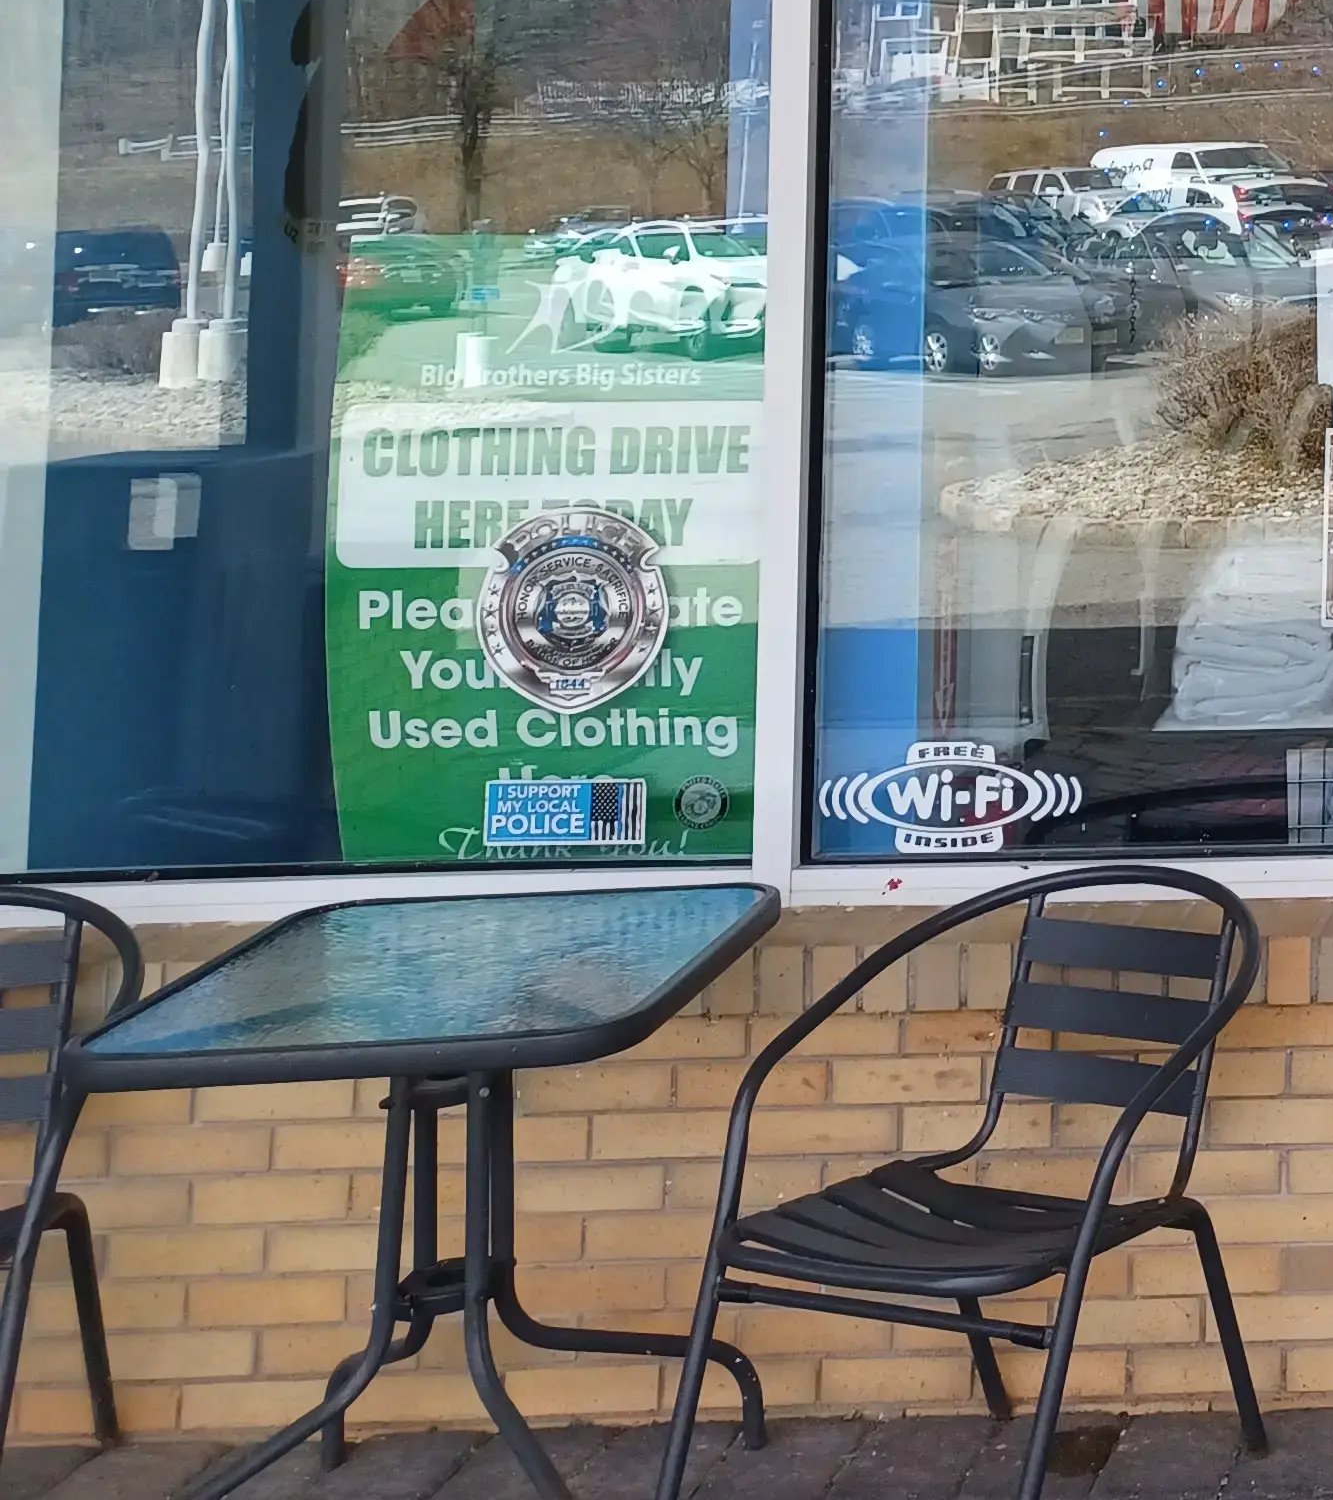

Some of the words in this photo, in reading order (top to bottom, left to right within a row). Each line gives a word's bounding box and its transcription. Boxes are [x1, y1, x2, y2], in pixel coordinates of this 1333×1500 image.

[576, 364, 614, 391] Big
[620, 363, 701, 386] Sisters
[363, 426, 598, 477] CLOTHING
[608, 426, 750, 475] DRIVE
[511, 514, 643, 558] POLICE
[359, 590, 476, 630] Plea
[666, 587, 743, 627] ate
[516, 575, 542, 622] HONOR
[540, 556, 591, 580] SERVICE
[597, 563, 629, 620] SACRIFICE
[400, 650, 509, 690] You
[369, 708, 498, 749] Used
[516, 707, 739, 758] Clothing
[918, 744, 986, 759] FREE
[497, 800, 522, 813] MY
[527, 800, 582, 813] LOCAL
[498, 786, 503, 799] I
[507, 785, 582, 799] SUPPORT
[886, 769, 1015, 822] Wi-Fi
[490, 814, 586, 836] POLICE
